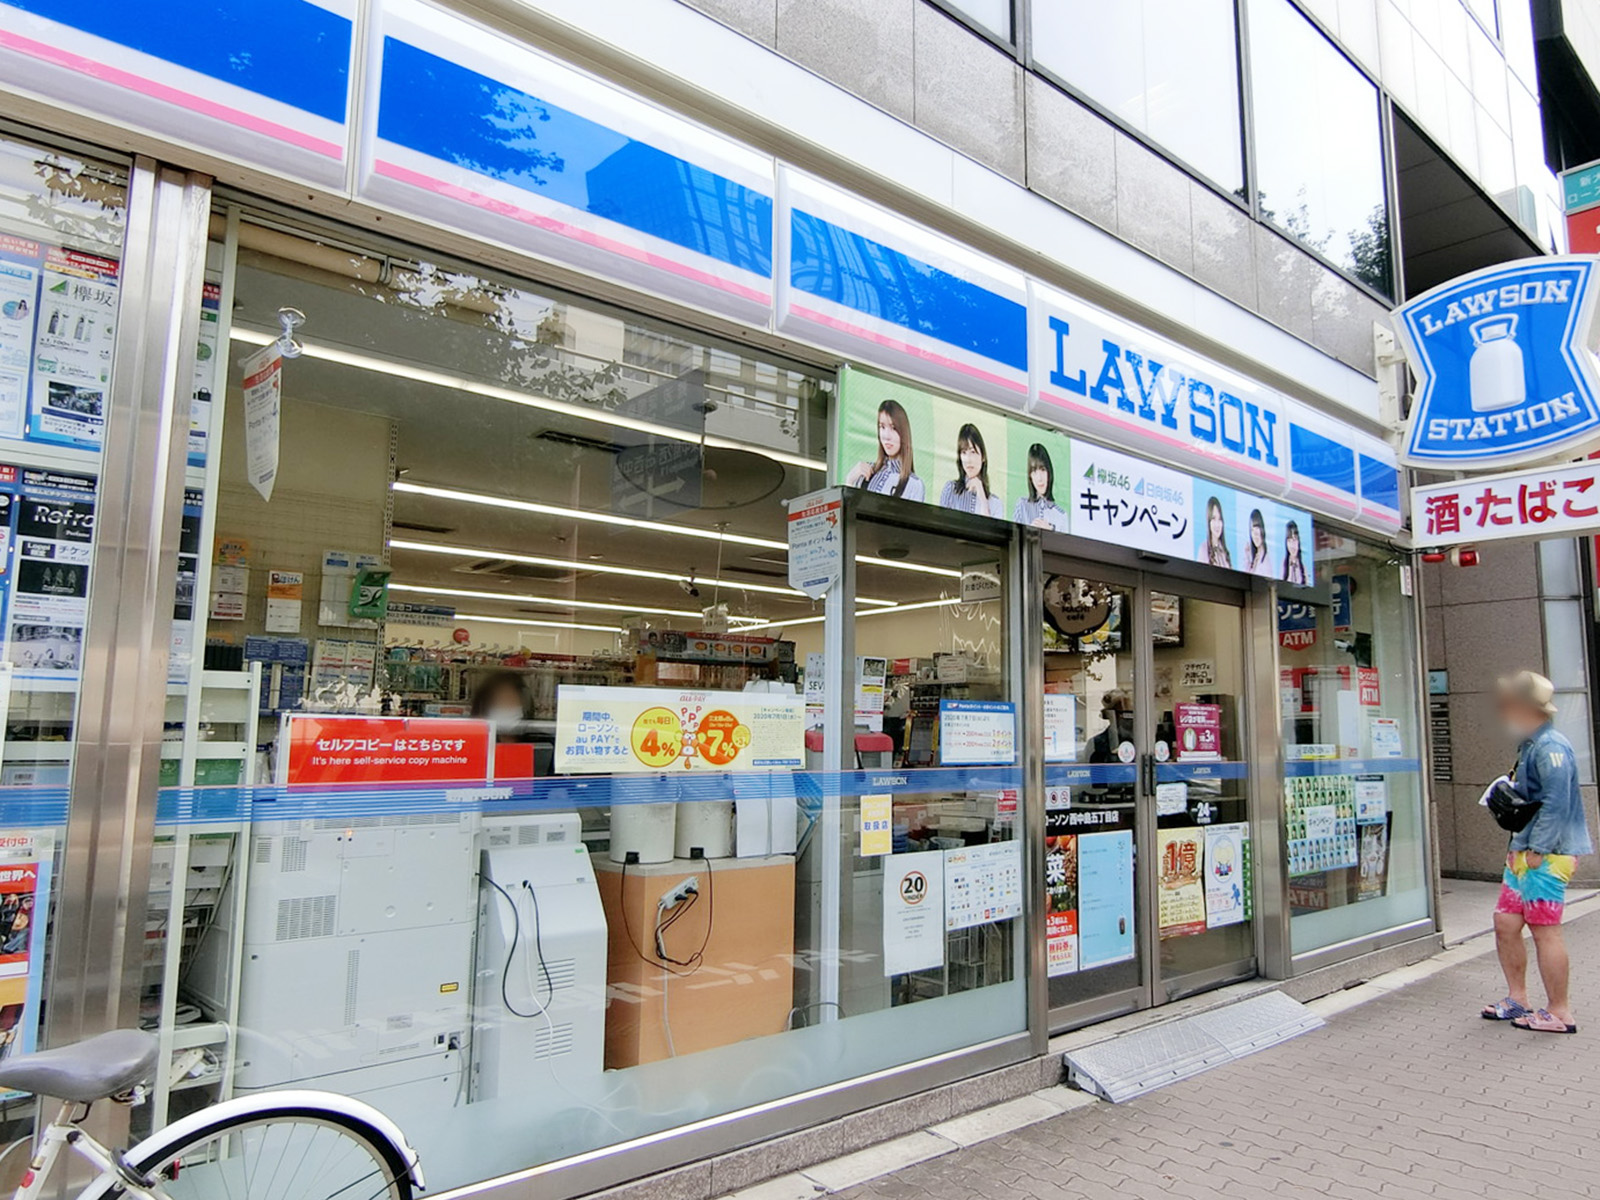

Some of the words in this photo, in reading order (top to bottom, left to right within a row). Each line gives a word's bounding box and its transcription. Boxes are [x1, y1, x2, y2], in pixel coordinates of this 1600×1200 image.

[1419, 279, 1572, 337] LAWSON
[1048, 315, 1279, 468] LAWSON
[1427, 391, 1582, 441] STATION
[1096, 467, 1131, 491] 欅坂46
[1146, 482, 1184, 506] 日向坂46
[1424, 476, 1599, 536] 酒・たばこ
[1079, 488, 1188, 540] キャンペーン
[1282, 631, 1314, 646] ATM
[808, 680, 825, 691] SEV
[1362, 687, 1379, 703] ATM
[316, 738, 467, 752] セルフコピーはこちらです
[640, 728, 676, 757] 4%
[707, 729, 736, 758] 7%
[312, 756, 327, 765] It's
[329, 757, 351, 765] here
[353, 756, 406, 765] self-service
[408, 756, 430, 767] copy
[431, 755, 468, 765] machine
[872, 776, 908, 786] LAWSON
[903, 876, 924, 894] 20
